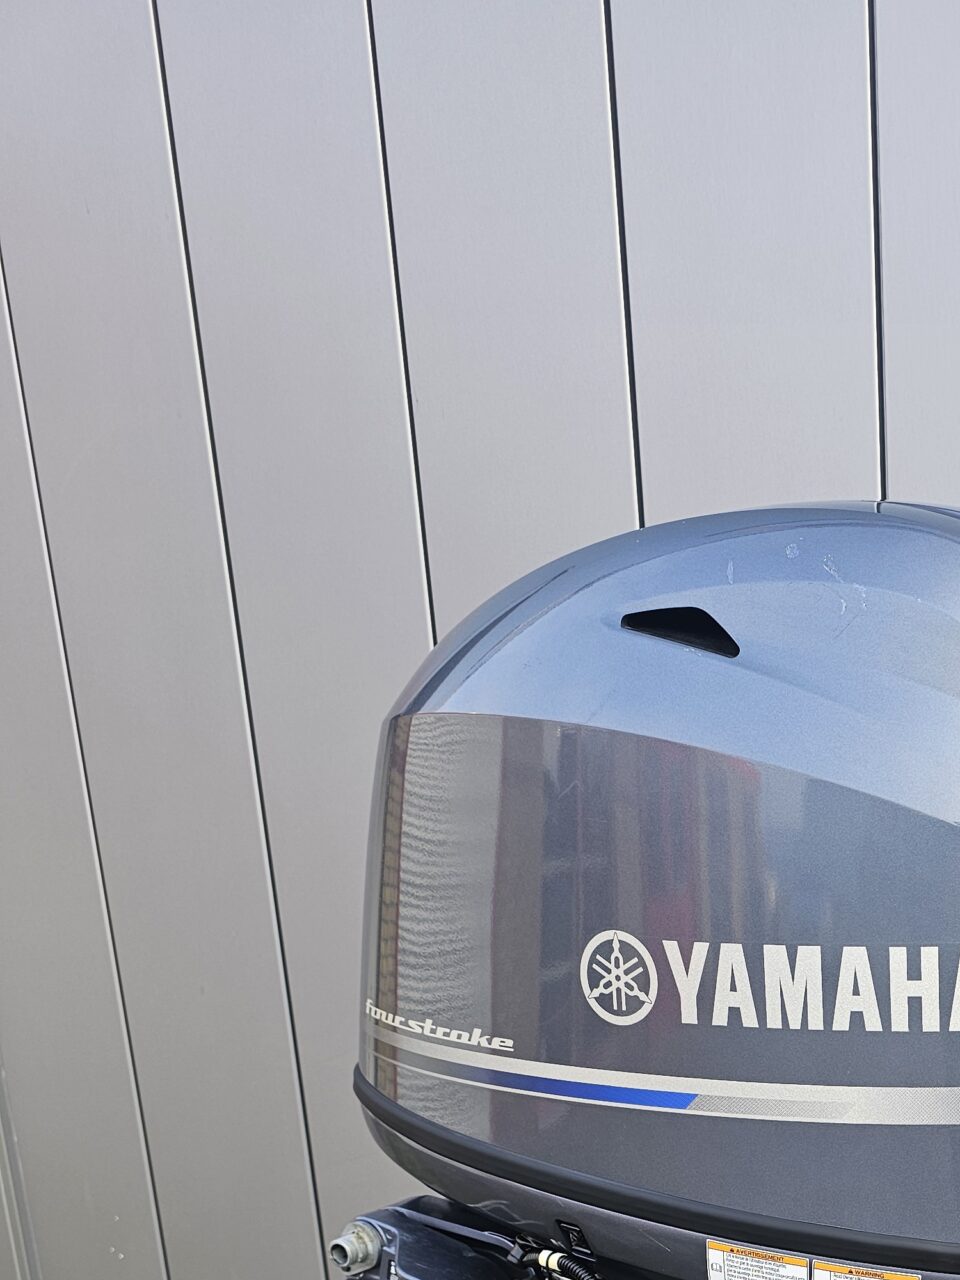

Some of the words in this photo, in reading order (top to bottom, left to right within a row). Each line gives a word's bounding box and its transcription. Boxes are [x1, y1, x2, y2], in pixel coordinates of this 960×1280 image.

[365, 998, 515, 1052] fourstroke
[736, 1248, 784, 1263] AVERTISSEMENT
[854, 1269, 885, 1279] WARNING
